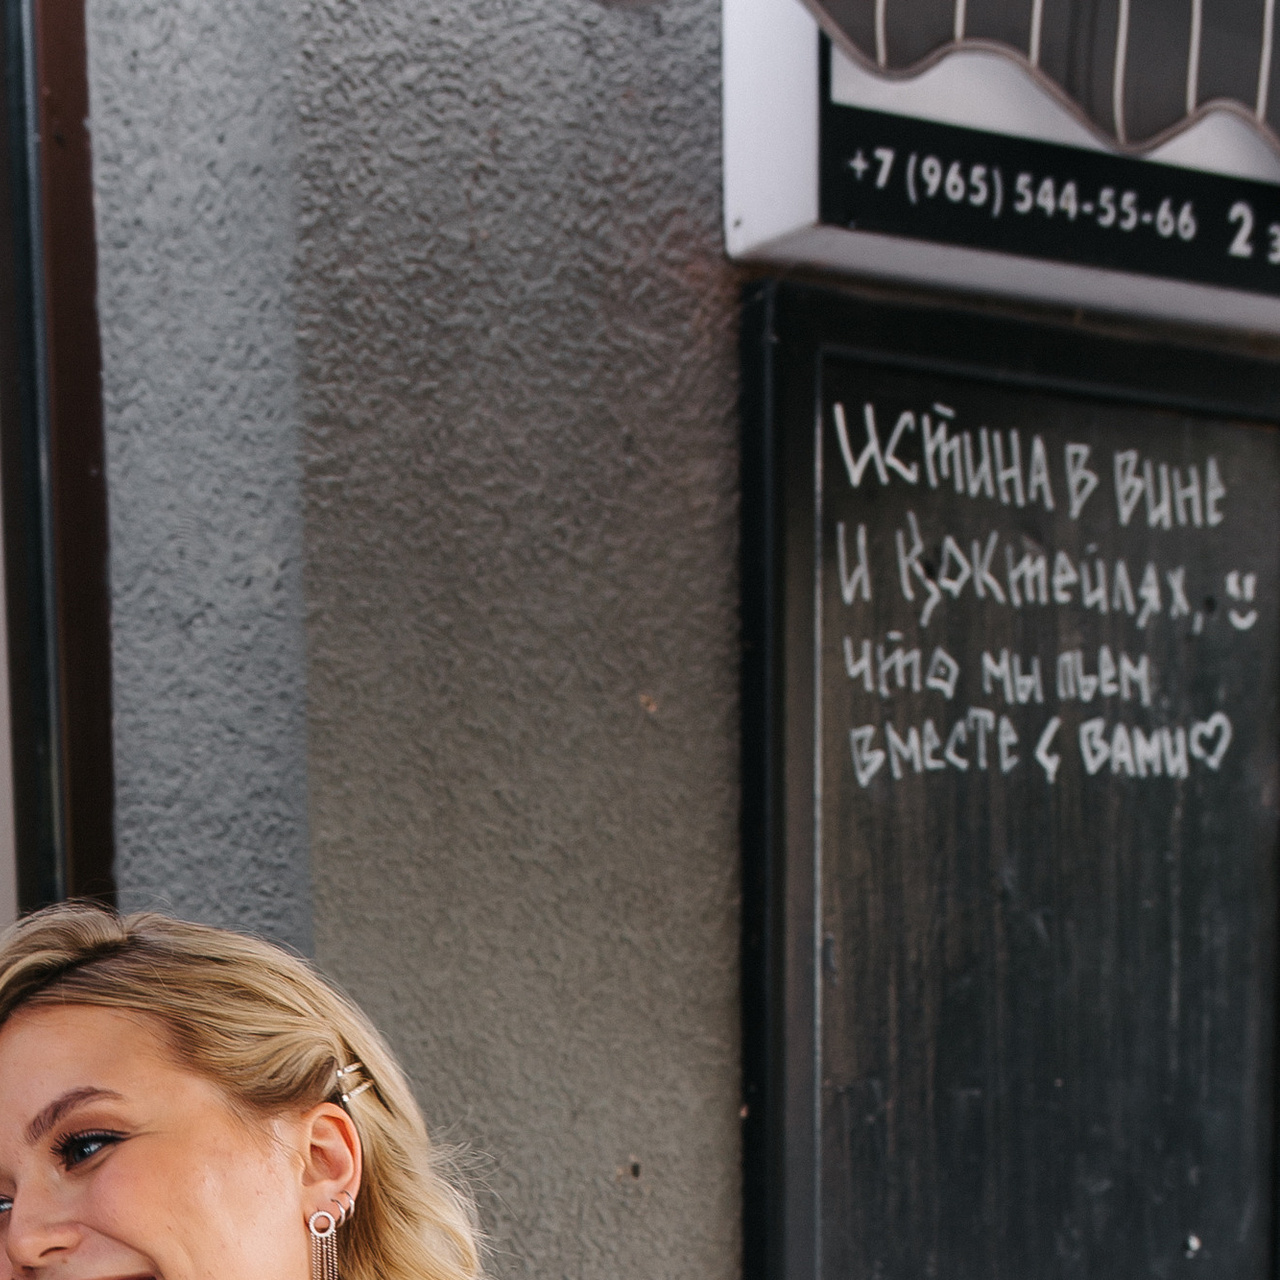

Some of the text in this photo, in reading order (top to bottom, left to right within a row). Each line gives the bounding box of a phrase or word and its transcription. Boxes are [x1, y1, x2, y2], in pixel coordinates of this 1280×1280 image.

[849, 148, 895, 190] +7
[905, 153, 1005, 217] (965)
[1015, 173, 1198, 241] 544-55-66
[1228, 203, 1255, 258] 2
